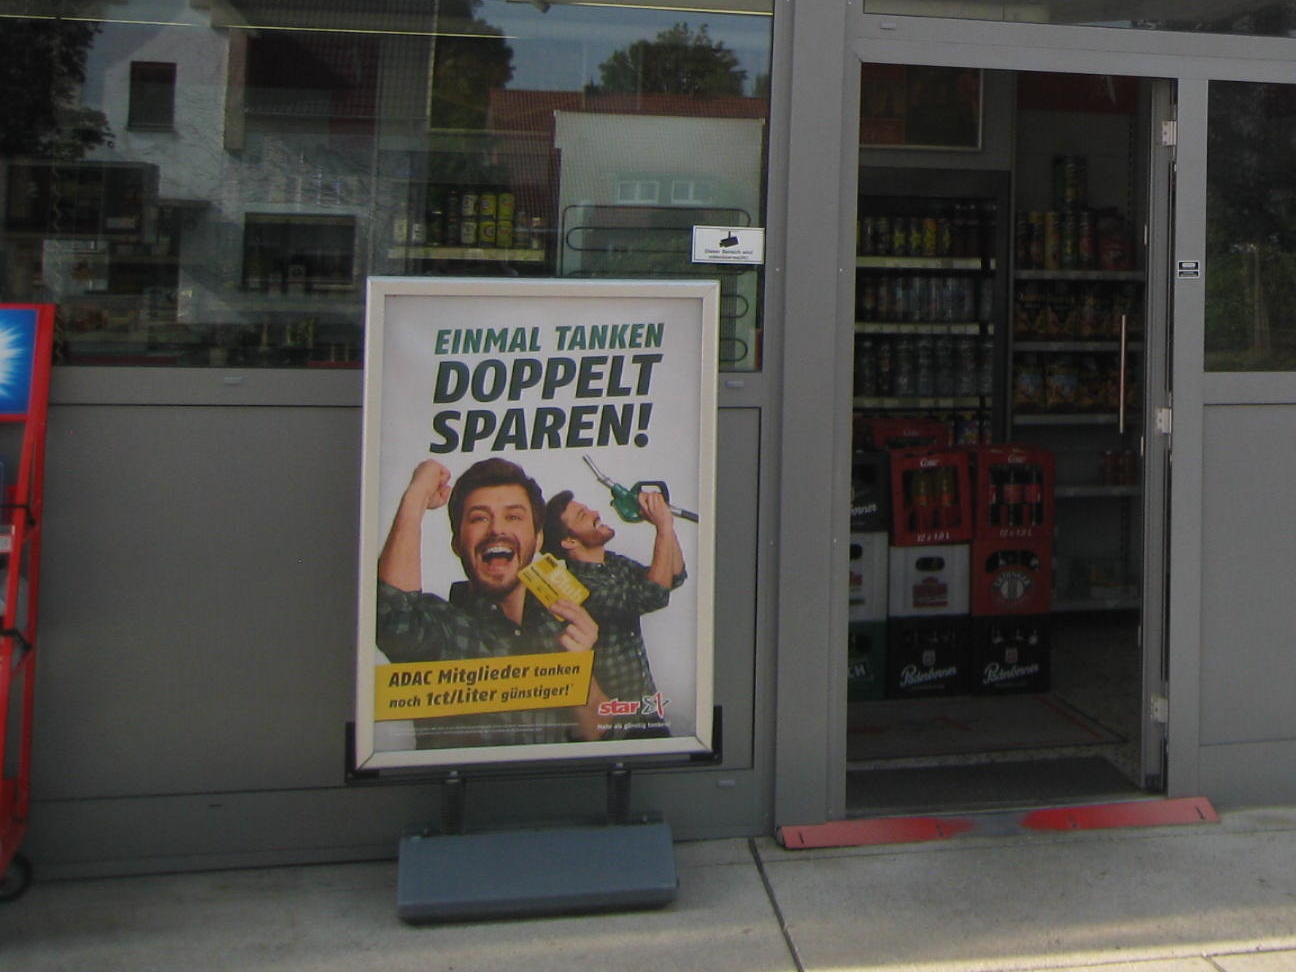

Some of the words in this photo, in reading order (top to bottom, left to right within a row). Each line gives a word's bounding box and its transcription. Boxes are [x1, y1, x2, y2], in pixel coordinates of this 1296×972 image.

[434, 326, 542, 355] EINMAL
[555, 322, 665, 351] TANKEN
[432, 353, 665, 405] DOPPELT
[429, 402, 654, 454] SPAREN!
[388, 670, 432, 688] ADAC
[438, 664, 530, 687] Mitglieder
[534, 663, 580, 678] tanken
[389, 695, 421, 709] noch
[426, 687, 497, 707] 1ct/Liter
[599, 698, 641, 716] star
